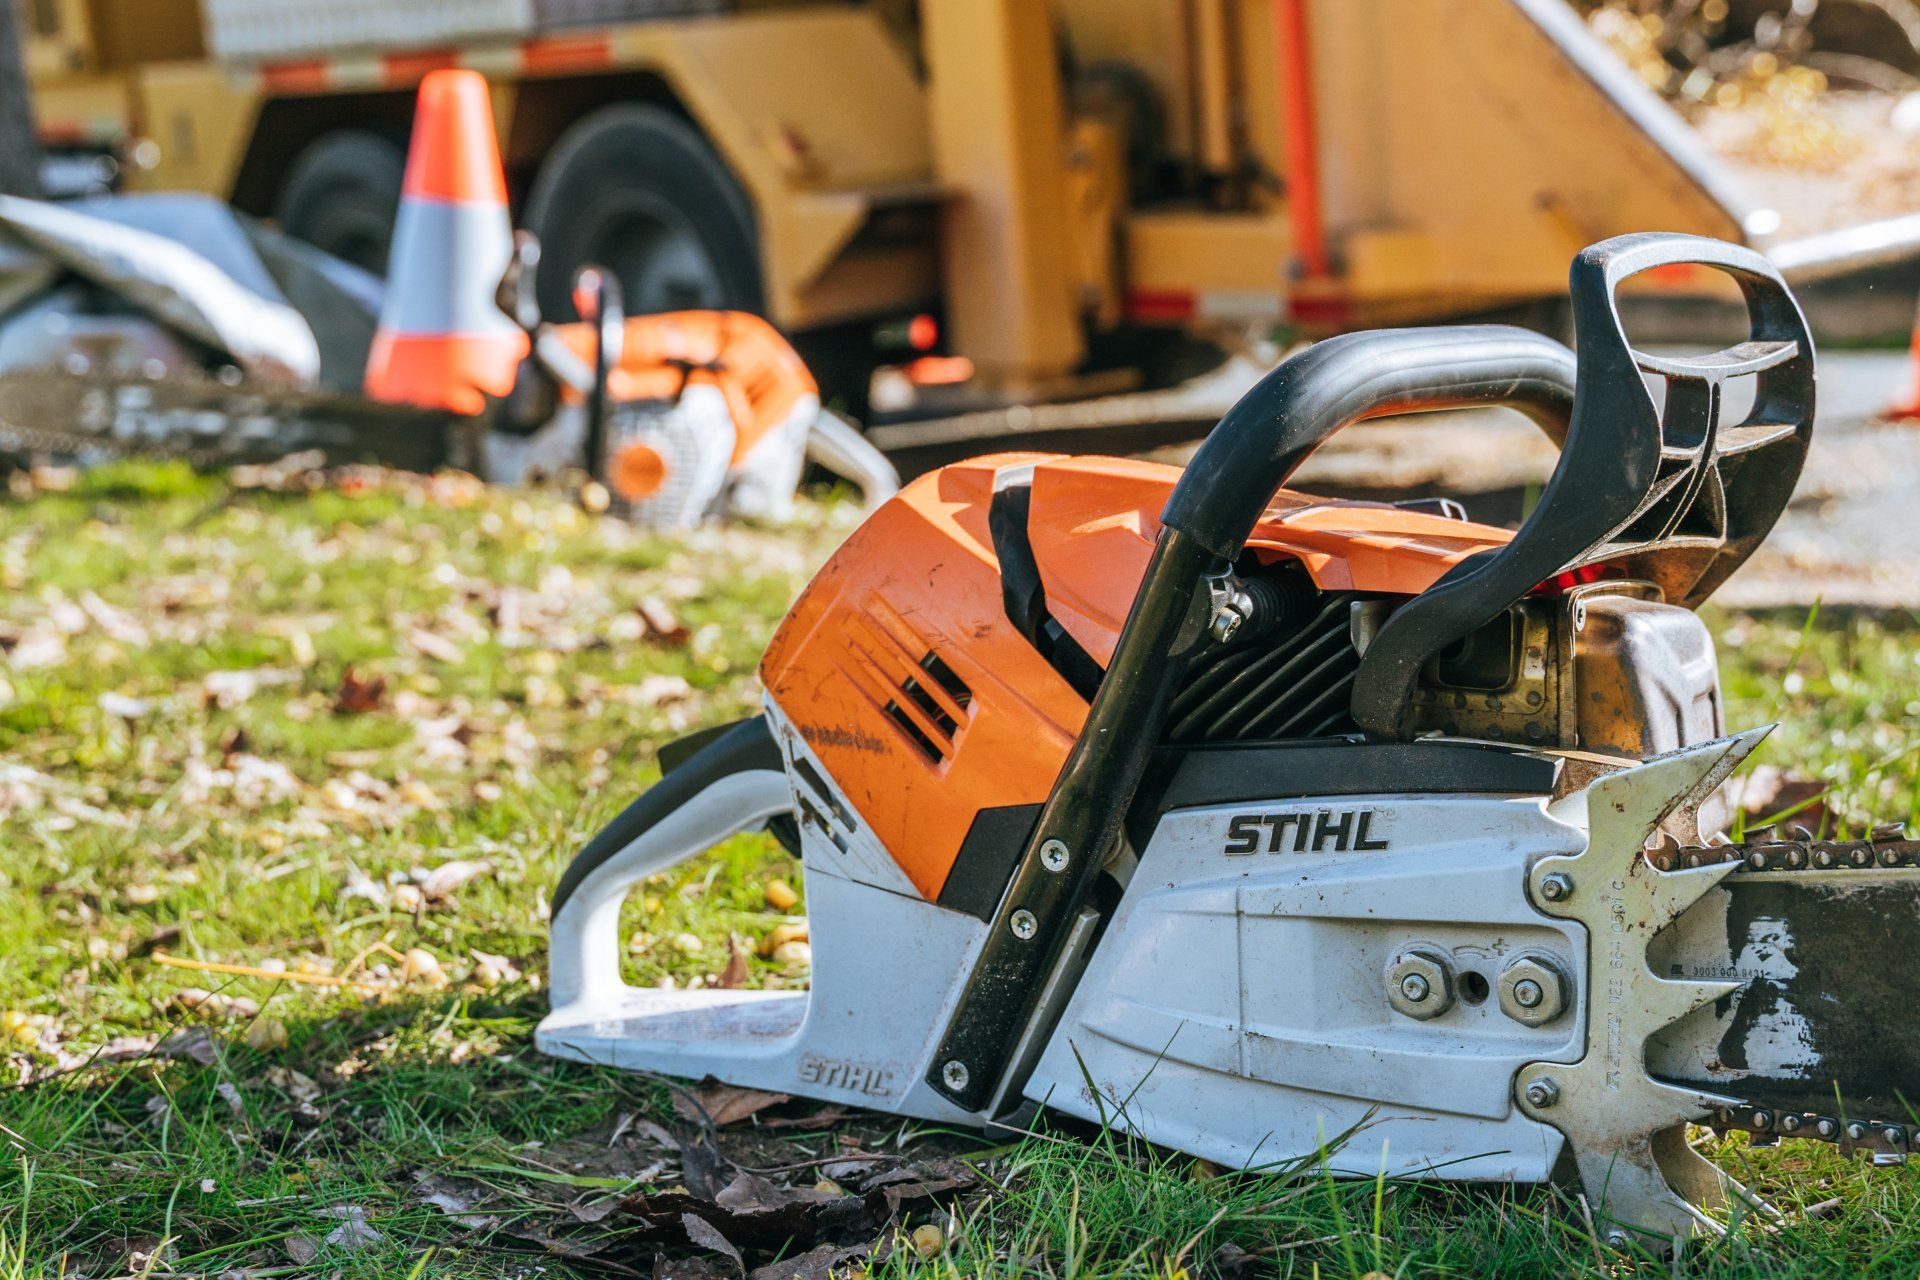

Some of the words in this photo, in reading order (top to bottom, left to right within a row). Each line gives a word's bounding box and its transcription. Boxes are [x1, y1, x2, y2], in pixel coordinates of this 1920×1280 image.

[1224, 810, 1389, 855] STIHL
[1693, 966, 1717, 977] 3003
[800, 1058, 890, 1096] STIHL
